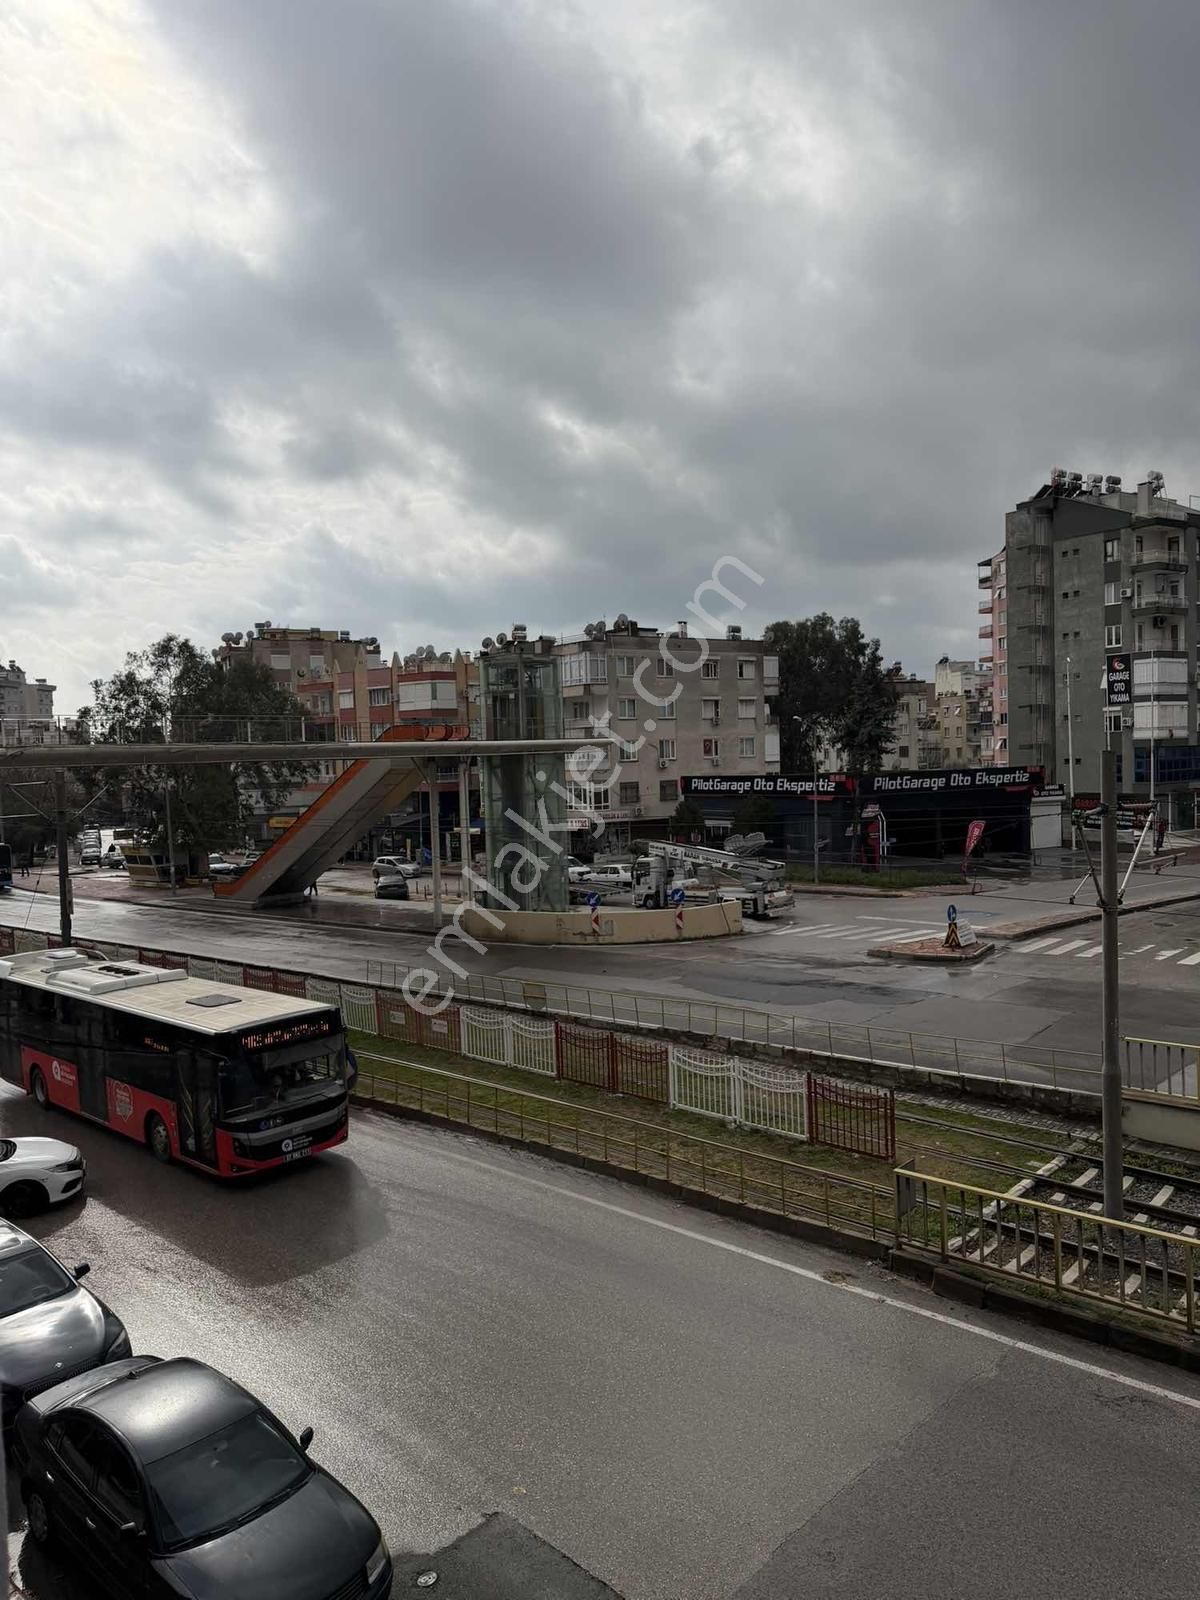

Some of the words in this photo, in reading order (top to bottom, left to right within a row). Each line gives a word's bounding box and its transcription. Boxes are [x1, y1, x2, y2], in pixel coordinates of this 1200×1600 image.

[1108, 671, 1130, 681] GARAGE
[1113, 682, 1126, 692] OTO
[691, 778, 752, 793] PilotGarage
[753, 778, 774, 791] Oto
[776, 778, 836, 794] Ekspertiz
[873, 775, 945, 791] PilotGarage
[950, 773, 971, 786] Oto
[974, 770, 1030, 787] Ekspertiz
